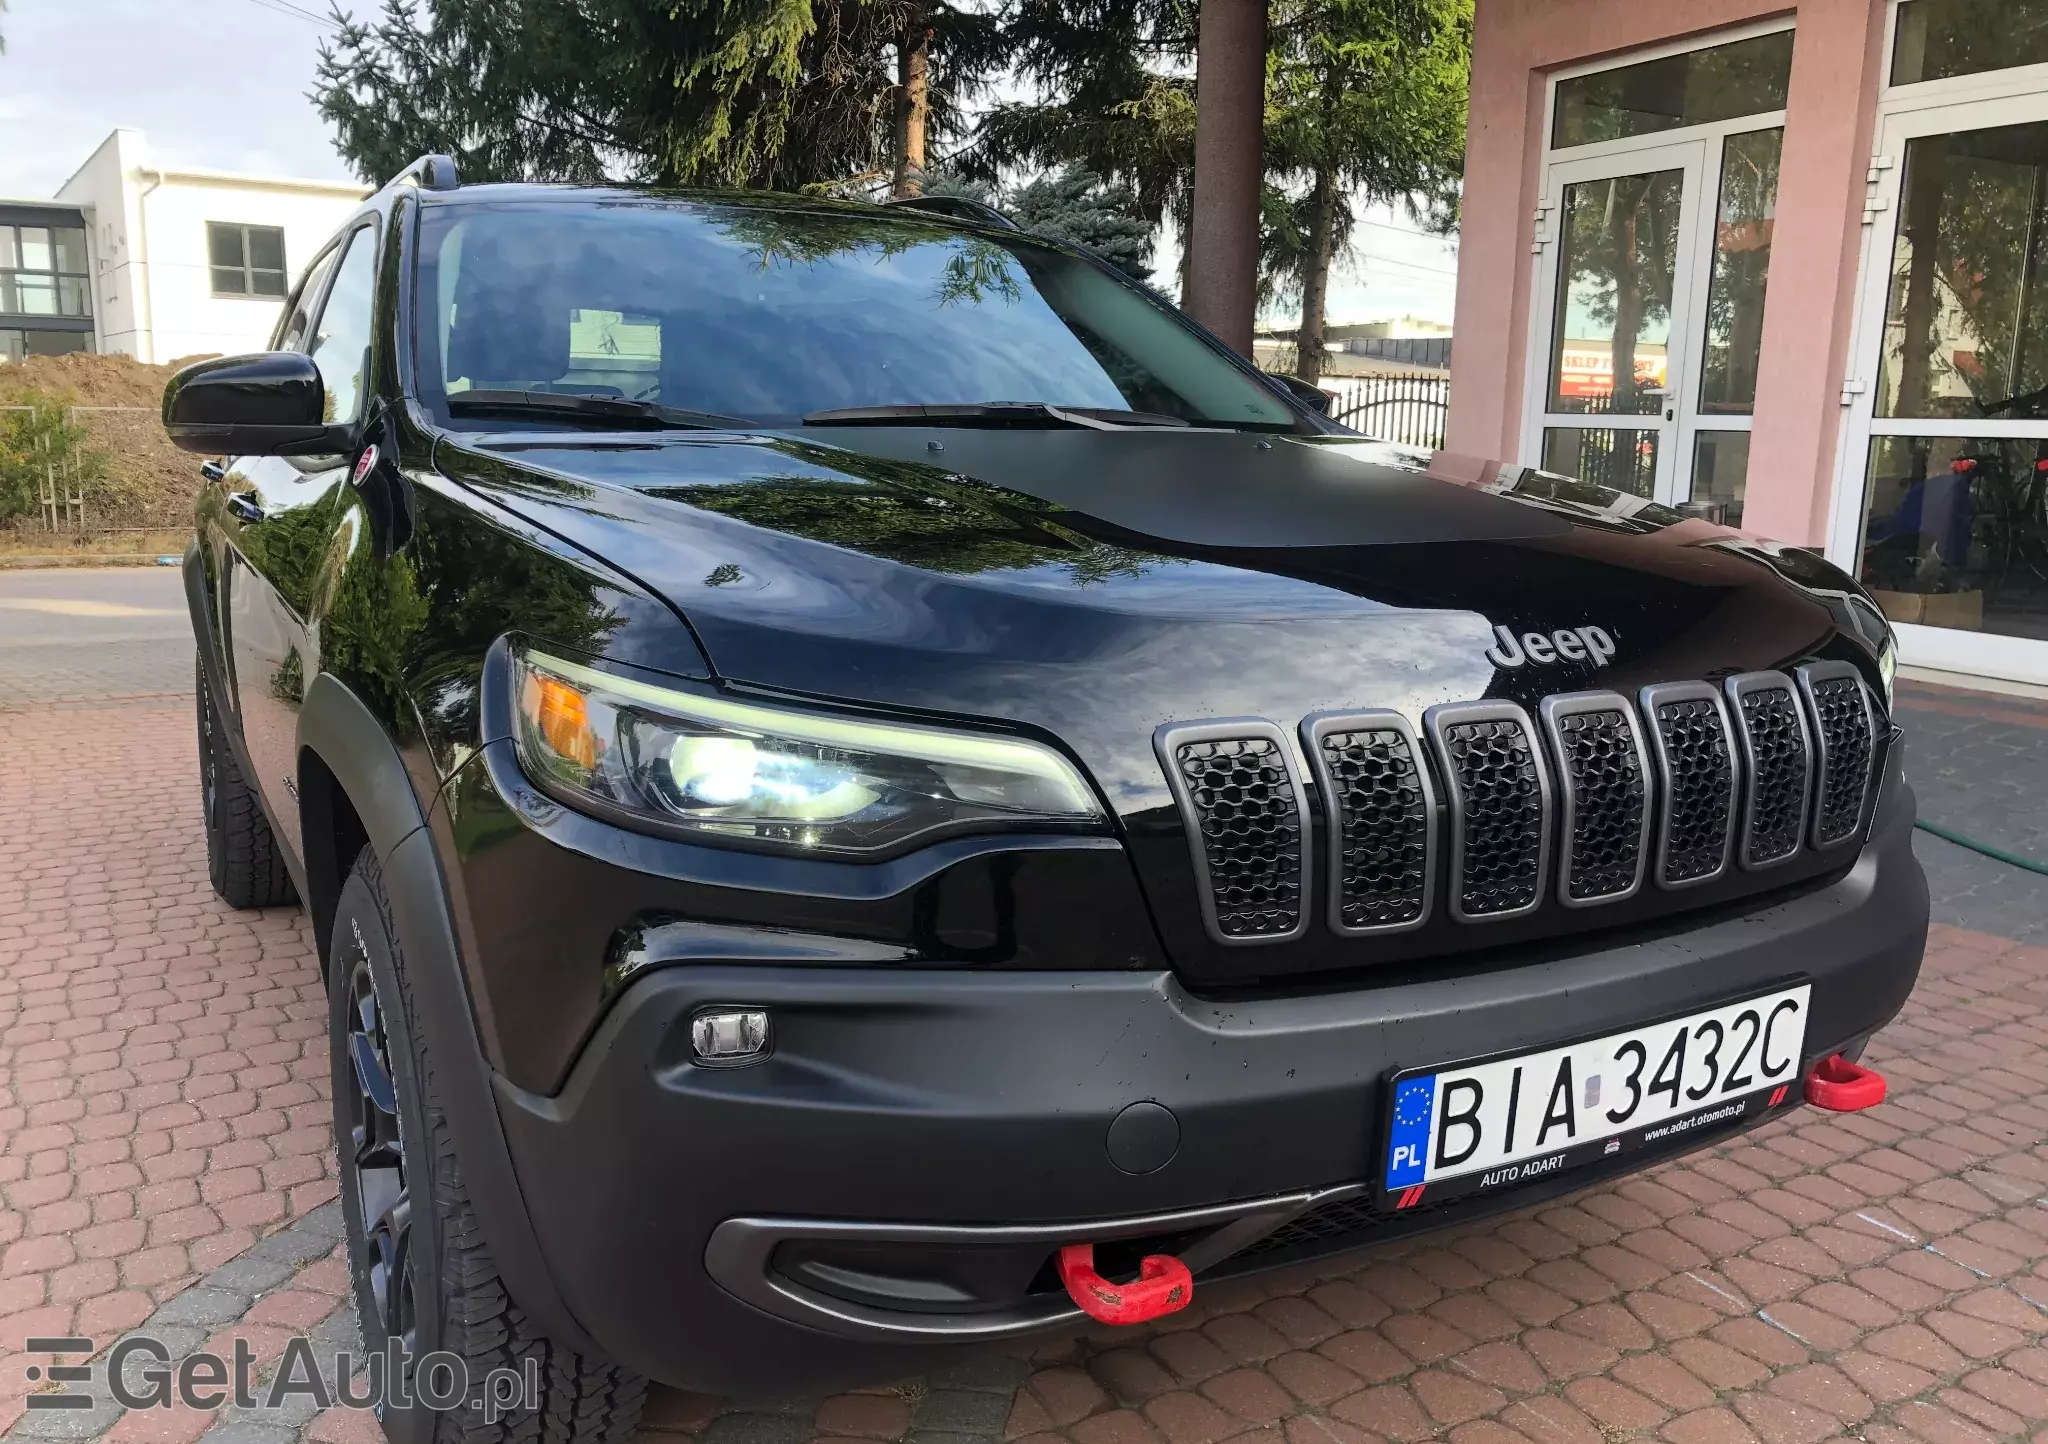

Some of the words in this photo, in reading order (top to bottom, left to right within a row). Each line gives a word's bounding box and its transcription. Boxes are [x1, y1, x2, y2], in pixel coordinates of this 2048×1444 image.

[1564, 355, 1599, 369] SKLEP
[1485, 624, 1616, 670] Jeep
[1433, 1055, 1577, 1170] BIA
[1605, 998, 1800, 1124] 3432C
[1643, 1100, 1746, 1142] www.adart.otomoto.pl
[1392, 1146, 1422, 1171] PL
[1479, 1167, 1518, 1188] AUTO
[1520, 1153, 1567, 1178] ADART
